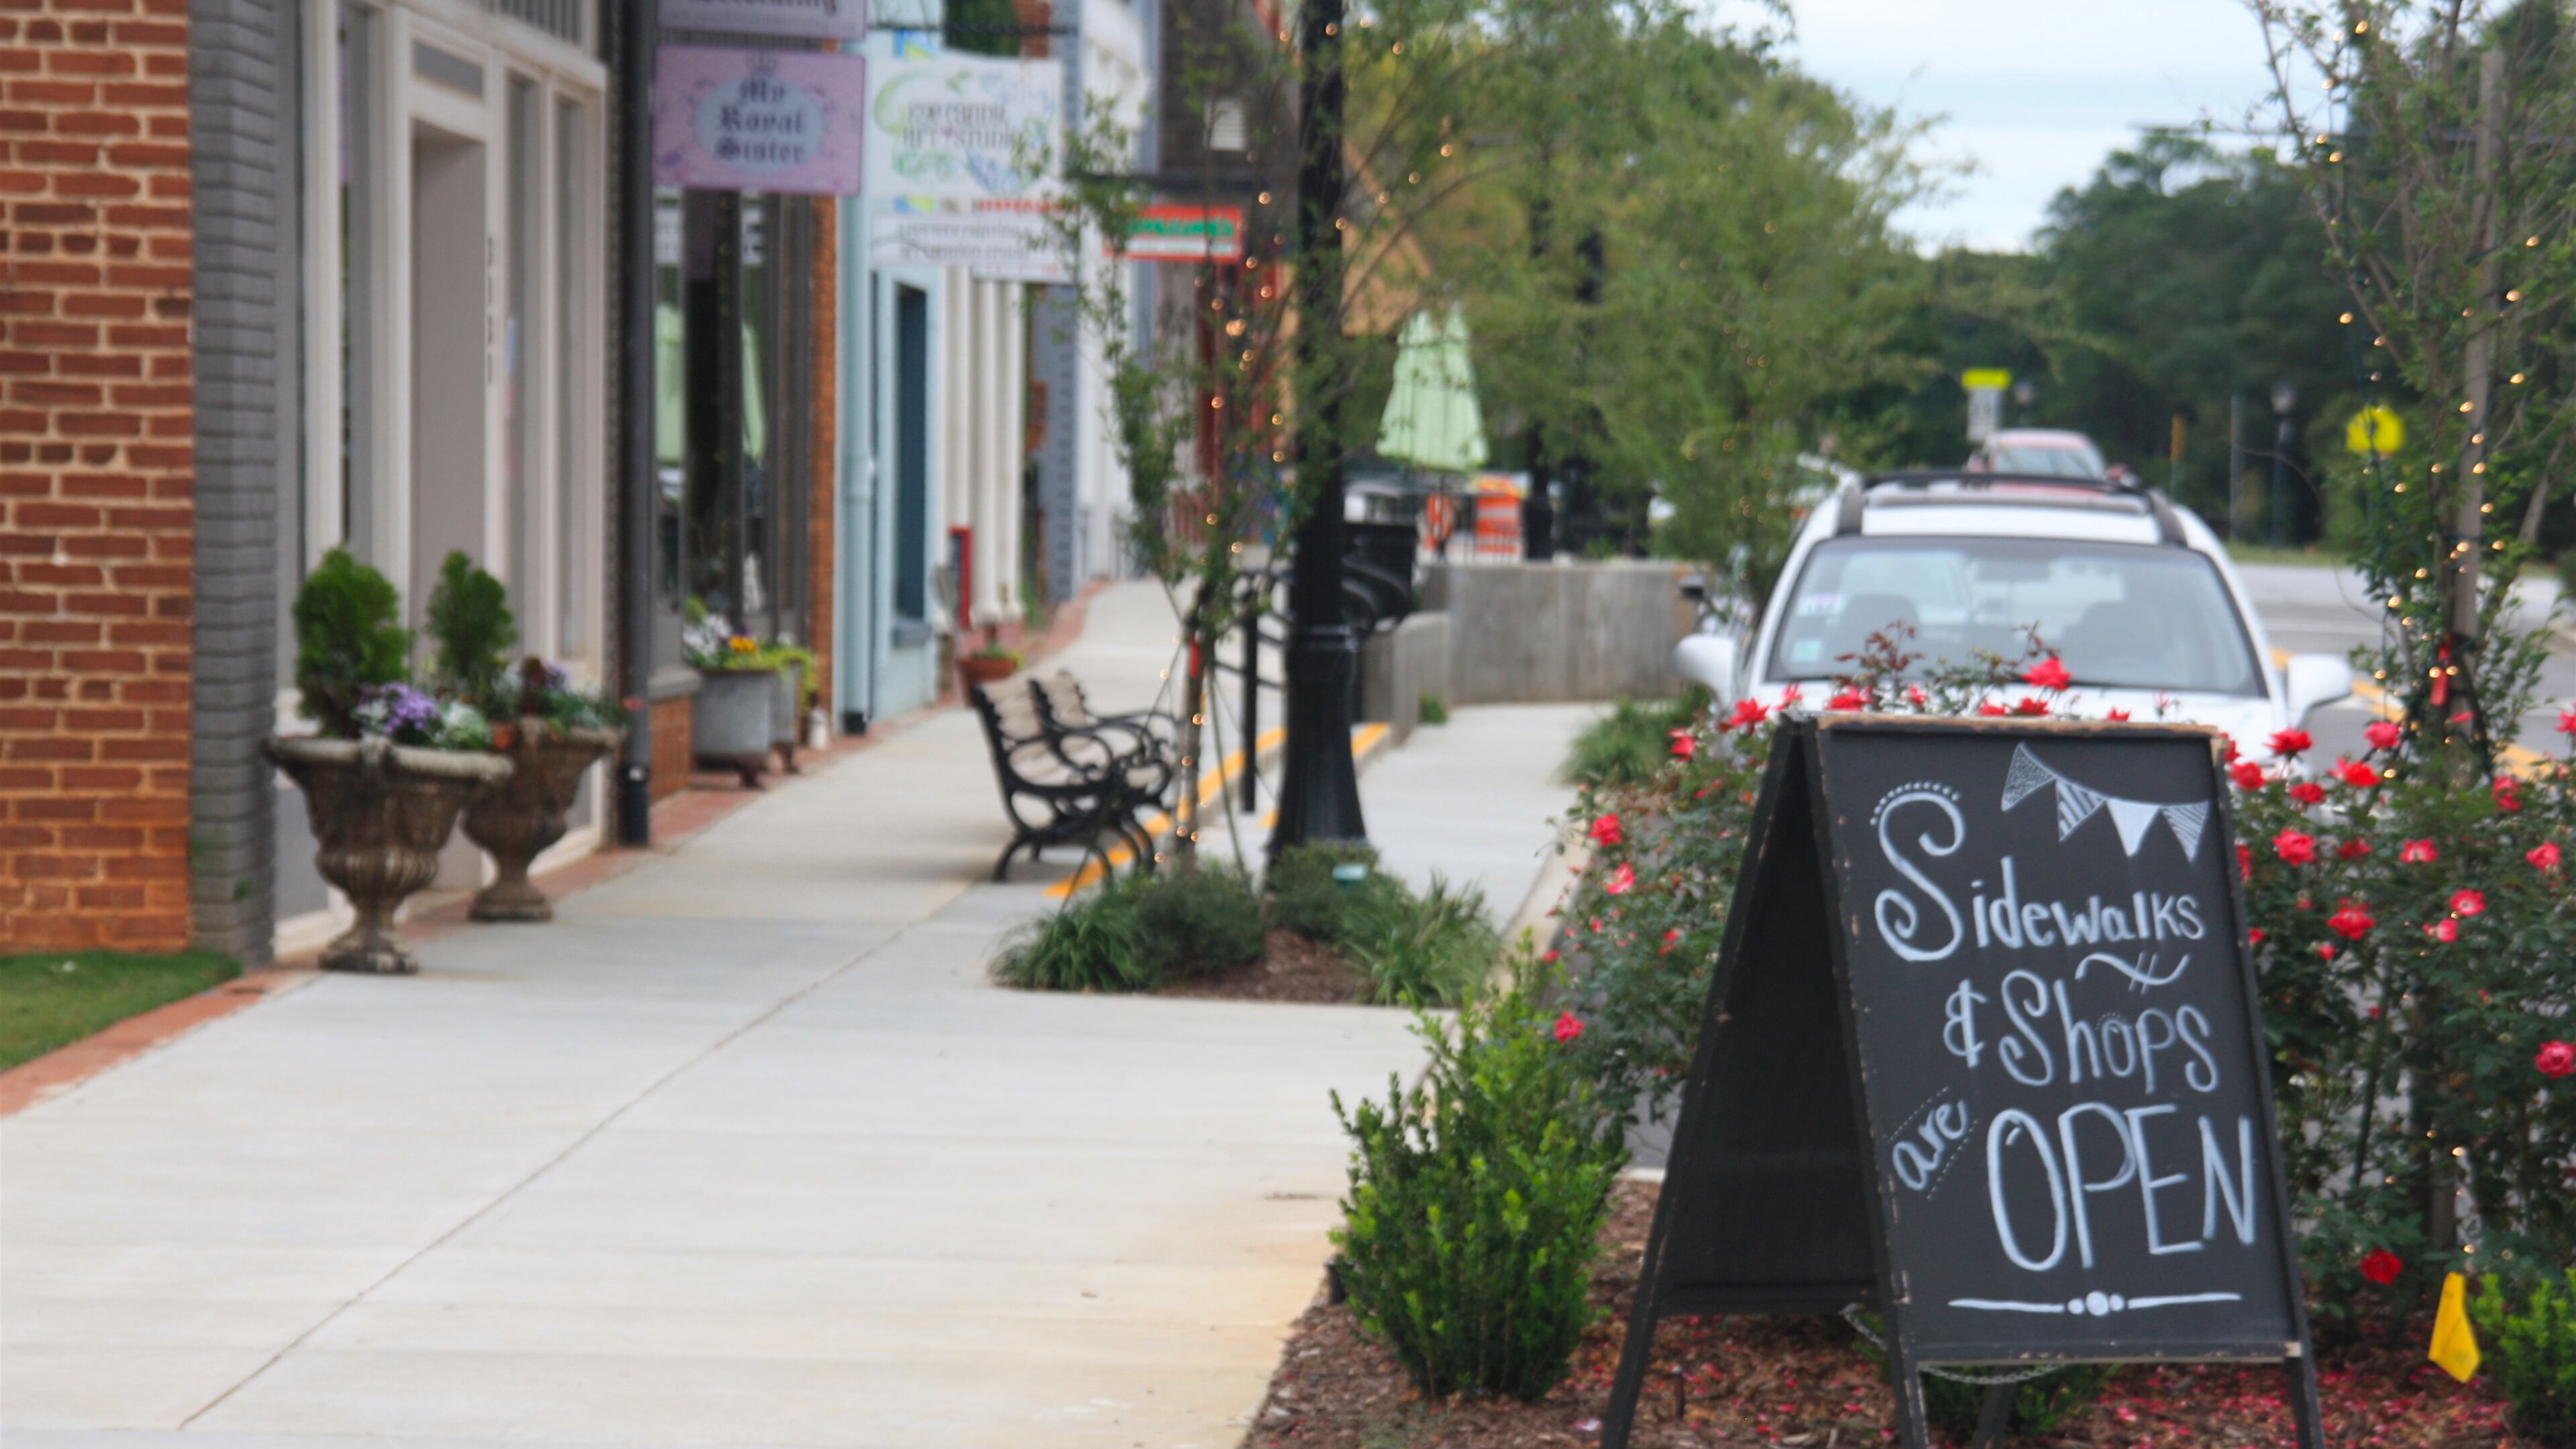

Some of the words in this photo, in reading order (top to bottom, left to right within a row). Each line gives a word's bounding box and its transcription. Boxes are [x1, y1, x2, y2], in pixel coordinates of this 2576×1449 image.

[720, 105, 803, 133] Royal
[739, 78, 786, 103] My
[714, 136, 804, 163] Sister
[1874, 789, 2207, 962] Sidewalks
[1943, 979, 1987, 1068] &
[1998, 969, 2218, 1094] Shops
[1892, 1099, 1969, 1192] are
[1986, 1102, 2255, 1272] OPEN
